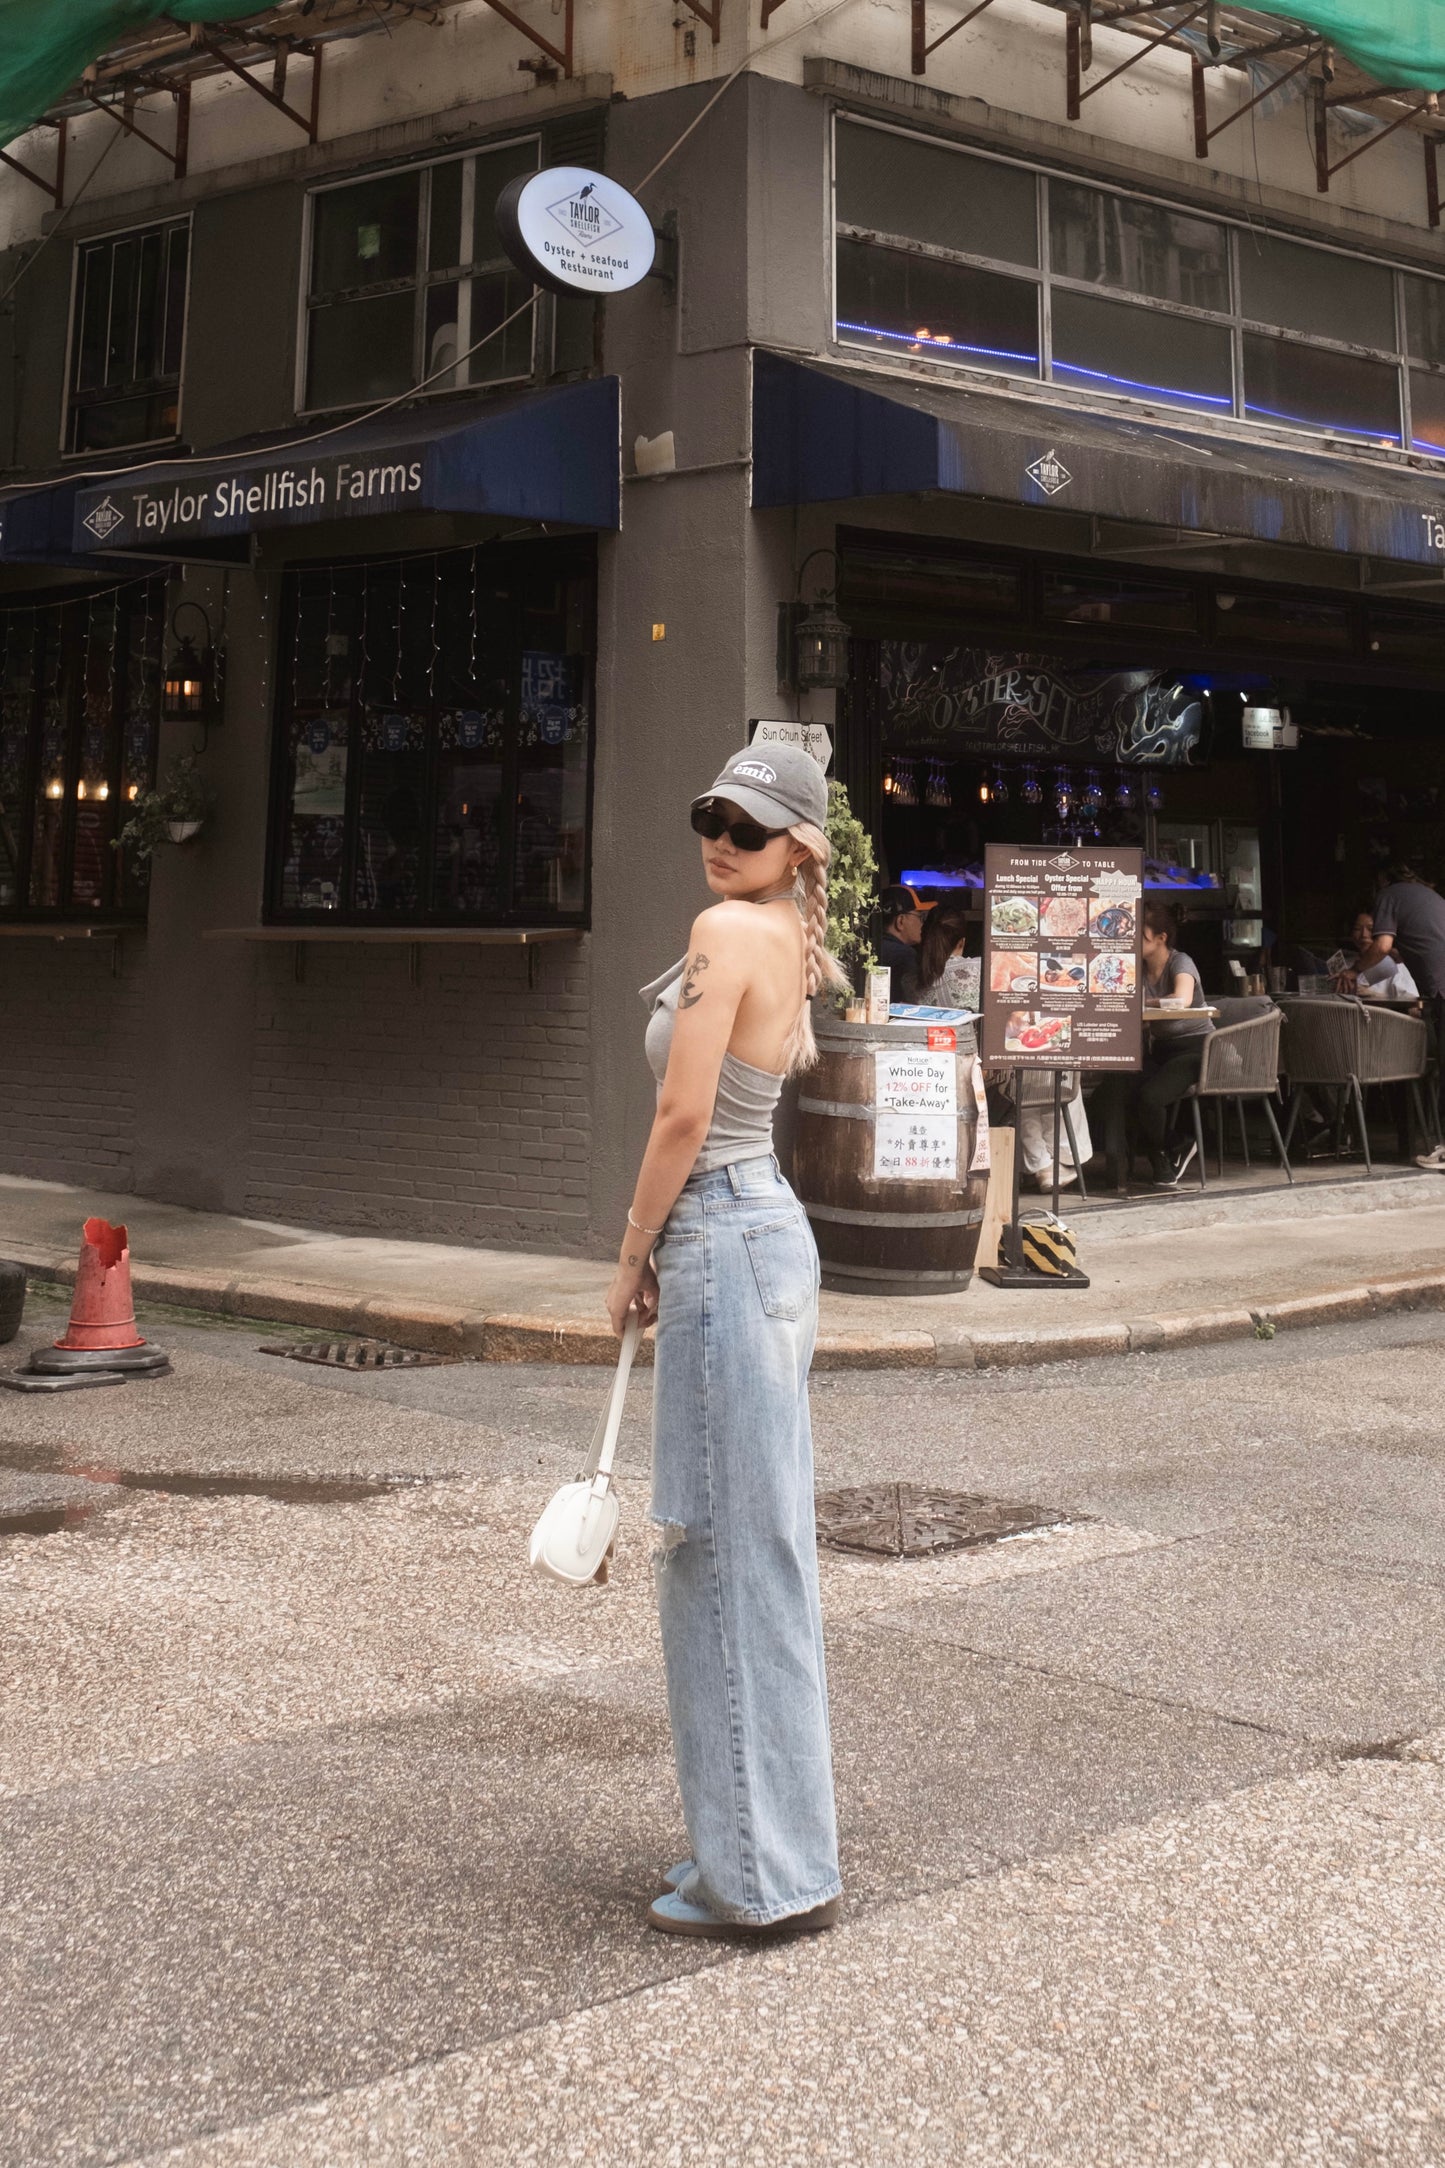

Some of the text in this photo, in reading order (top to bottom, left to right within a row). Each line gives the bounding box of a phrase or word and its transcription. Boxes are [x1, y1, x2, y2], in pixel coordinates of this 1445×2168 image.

[570, 201, 600, 224] TAYLOR
[570, 219, 600, 233] SHELLFISH
[544, 241, 576, 258] Oyster
[590, 253, 629, 270] seafood
[560, 259, 614, 280] Restaurant
[133, 462, 422, 534] Taylor Shellfish Farms
[933, 669, 1077, 740] OYSTER SET
[762, 727, 823, 743] Sun Chun Street
[733, 764, 773, 784] emis
[996, 874, 1038, 884] Lunch Special
[1044, 874, 1089, 884] Oyster Special
[1097, 878, 1117, 886] HAPPY
[889, 1067, 945, 1080] Whole Day
[886, 1082, 948, 1093] 12% OFF for
